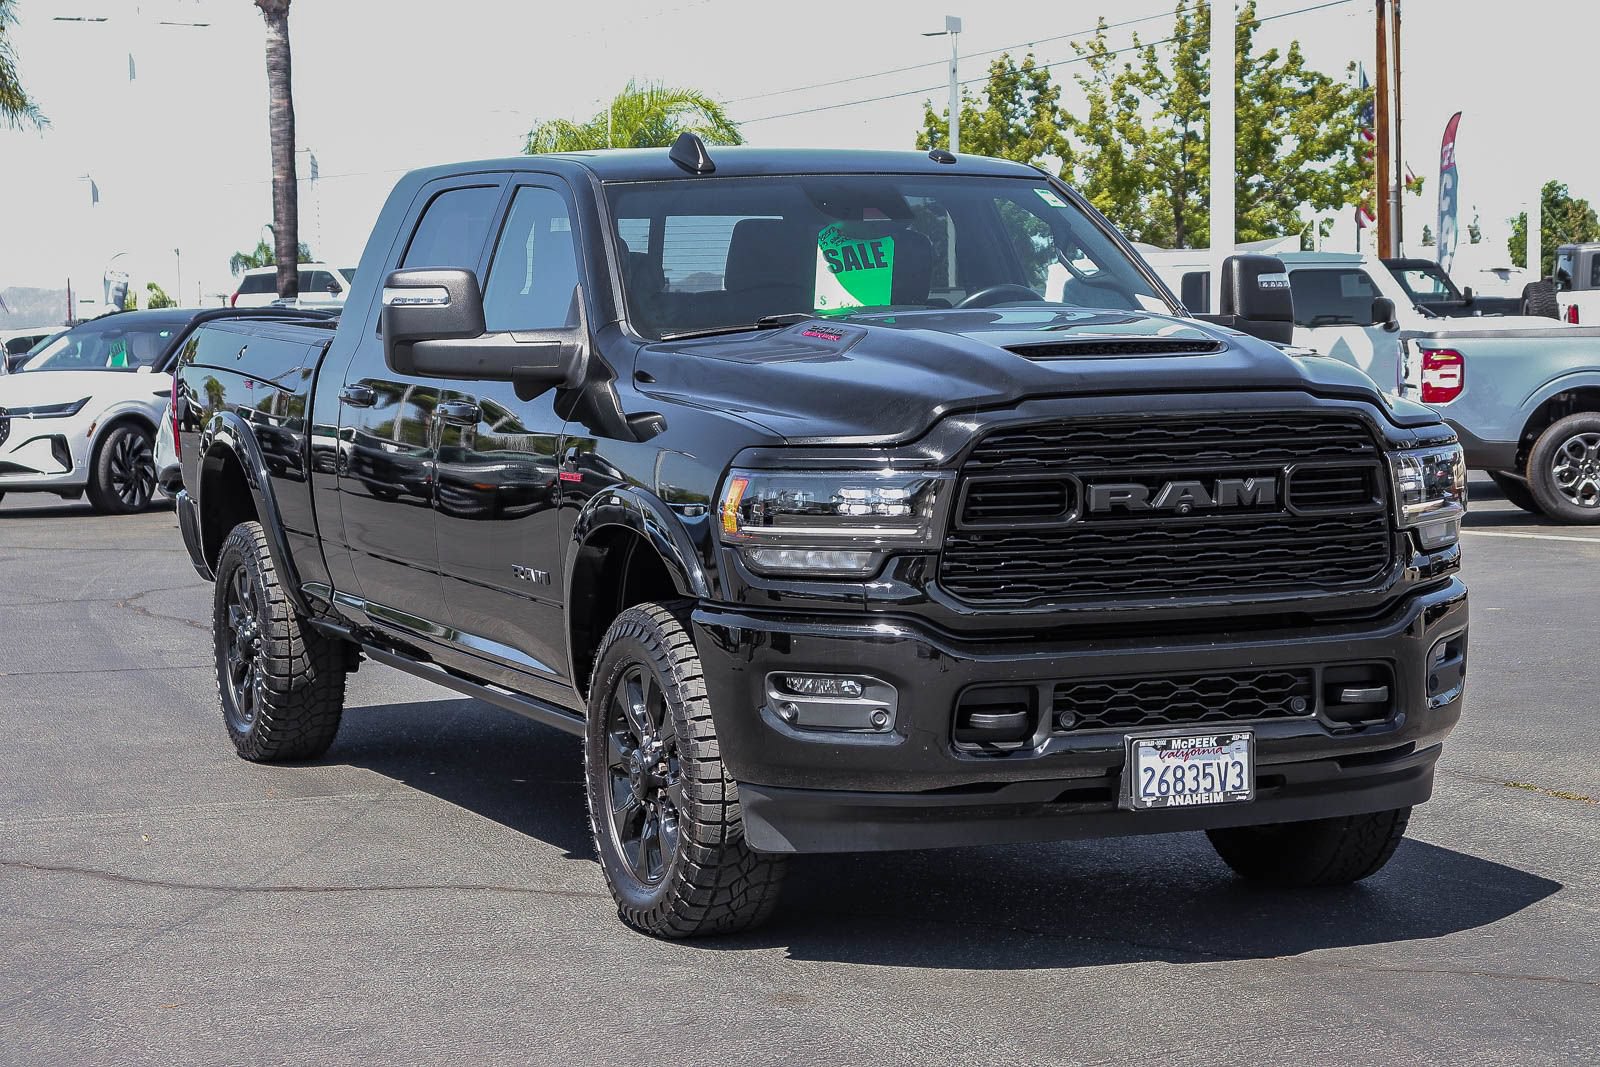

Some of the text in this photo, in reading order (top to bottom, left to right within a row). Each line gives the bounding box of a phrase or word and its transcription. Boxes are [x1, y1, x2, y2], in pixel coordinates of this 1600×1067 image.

[823, 242, 888, 274] SALE
[1086, 478, 1277, 512] RAM
[1159, 746, 1230, 762] California
[1171, 737, 1218, 750] McPEEK
[1142, 761, 1244, 797] 26835V3
[1167, 792, 1224, 806] ANAHEIM
